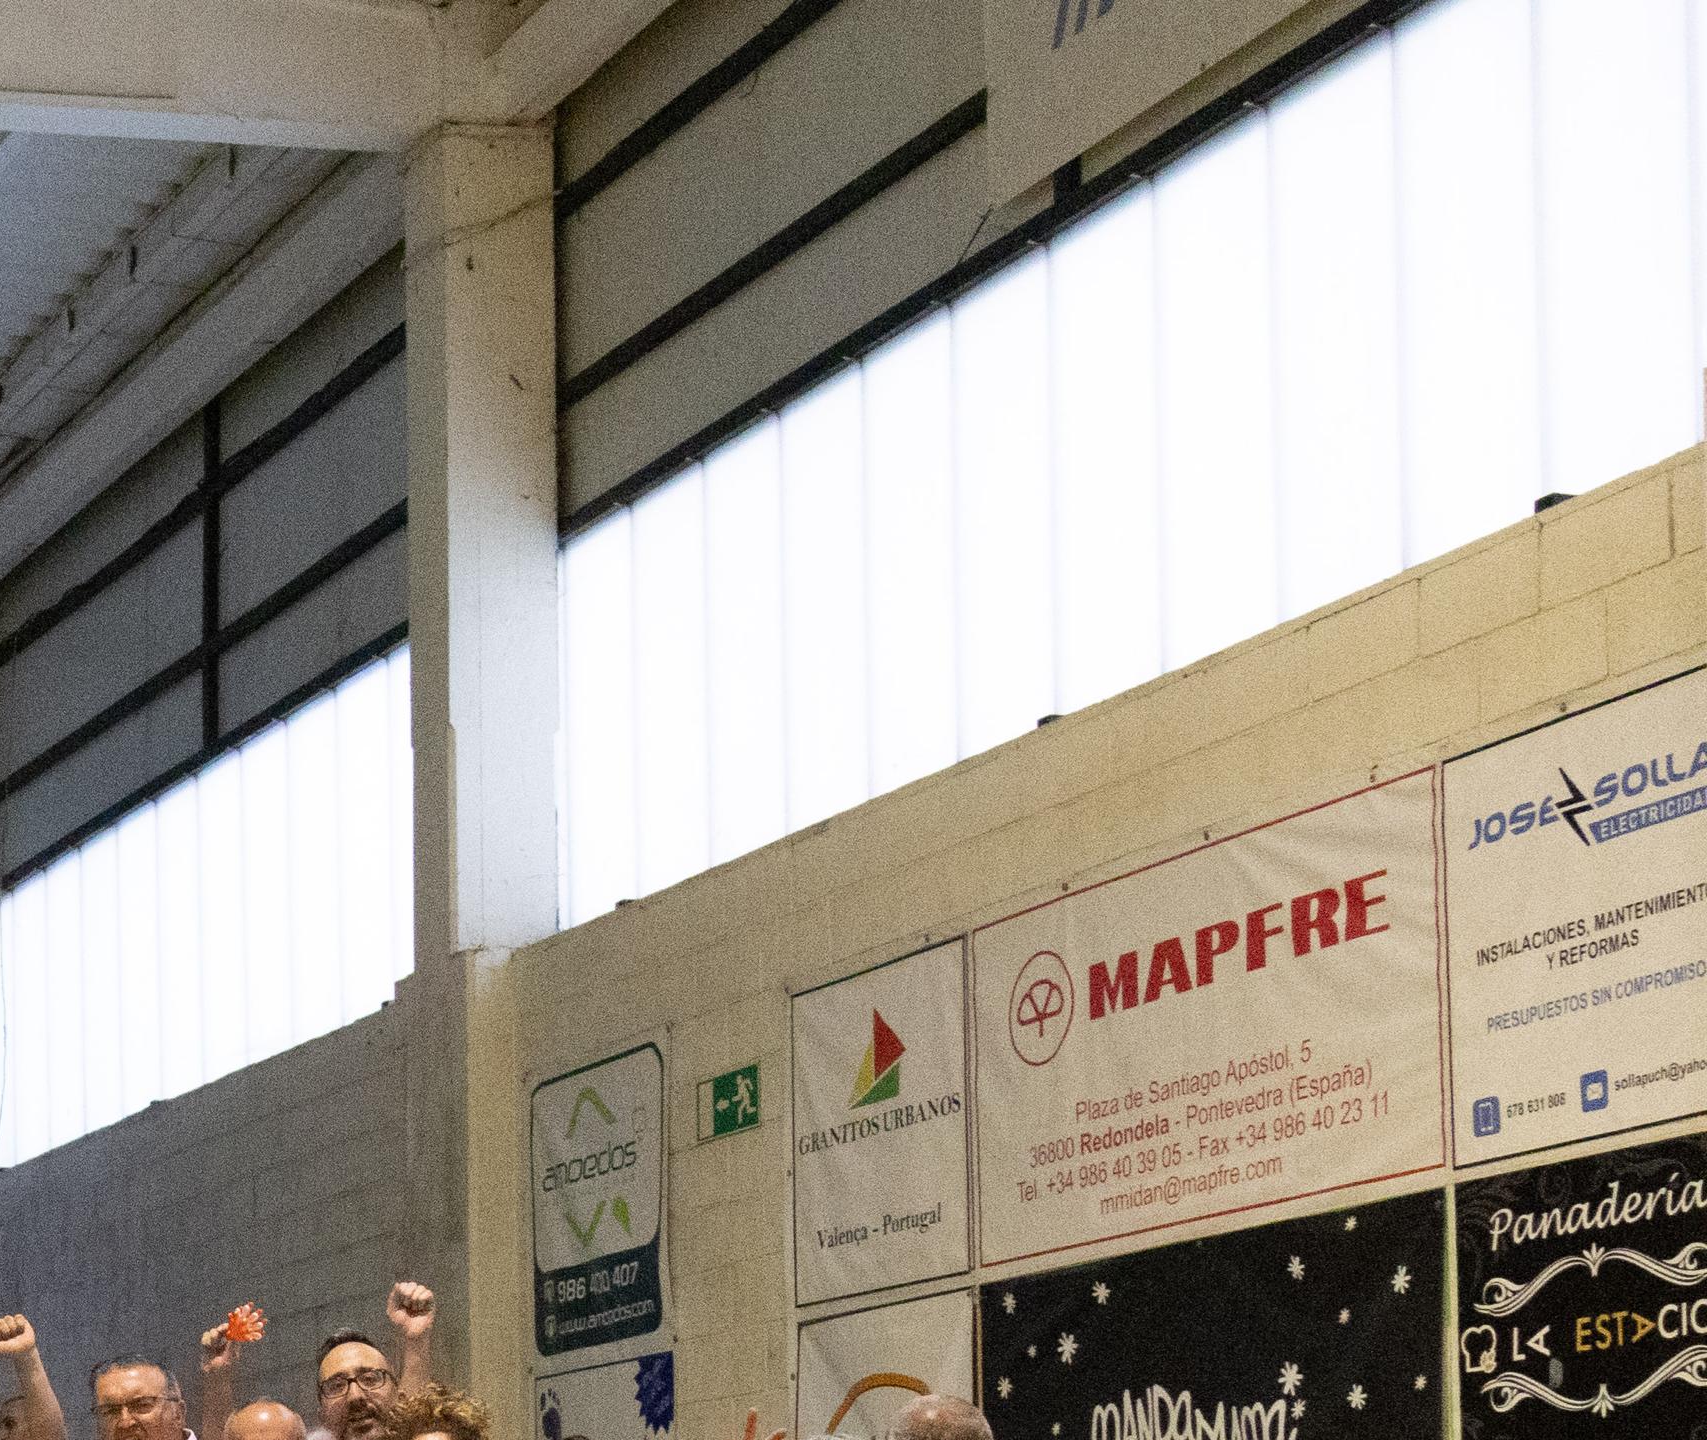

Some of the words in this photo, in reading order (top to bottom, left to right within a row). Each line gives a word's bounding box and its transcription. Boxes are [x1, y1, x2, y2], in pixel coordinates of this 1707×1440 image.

[1600, 789, 1707, 839] ELECTRICIDA
[1593, 882, 1707, 931] MANTENIMIENT
[1086, 869, 1390, 1025] MAPFRE
[1546, 952, 1555, 970] Y
[1559, 928, 1640, 970] REFORMAS
[1487, 993, 1588, 1034] PRESUPUESTOS
[1591, 986, 1613, 1006] SIN
[1076, 1097, 1119, 1122] Plaza
[1124, 1087, 1143, 1110] de
[1148, 1069, 1220, 1104] Santiago
[1300, 1038, 1312, 1063] 5
[798, 1115, 880, 1155] GRANITOS
[882, 1092, 961, 1132] URBANOS
[1029, 1136, 1076, 1169] 36800
[1080, 1113, 1170, 1156] Redondela
[1186, 1086, 1283, 1129] Pontevedra
[1289, 1058, 1372, 1103] (España)
[1046, 1169, 1074, 1195] +34
[1078, 1161, 1108, 1188] 986
[1112, 1154, 1132, 1178] 40
[1136, 1149, 1157, 1174] 39
[1161, 1142, 1183, 1167] 05
[1198, 1136, 1230, 1160] Fax
[1235, 1121, 1267, 1149] +34
[1273, 1113, 1306, 1141] 986
[1312, 1104, 1334, 1131] 40
[1340, 1097, 1363, 1125] 23
[1370, 1090, 1389, 1118] 11
[816, 1225, 868, 1250] Valença
[882, 1201, 942, 1236] Portugal
[1489, 1172, 1707, 1252] Panadería
